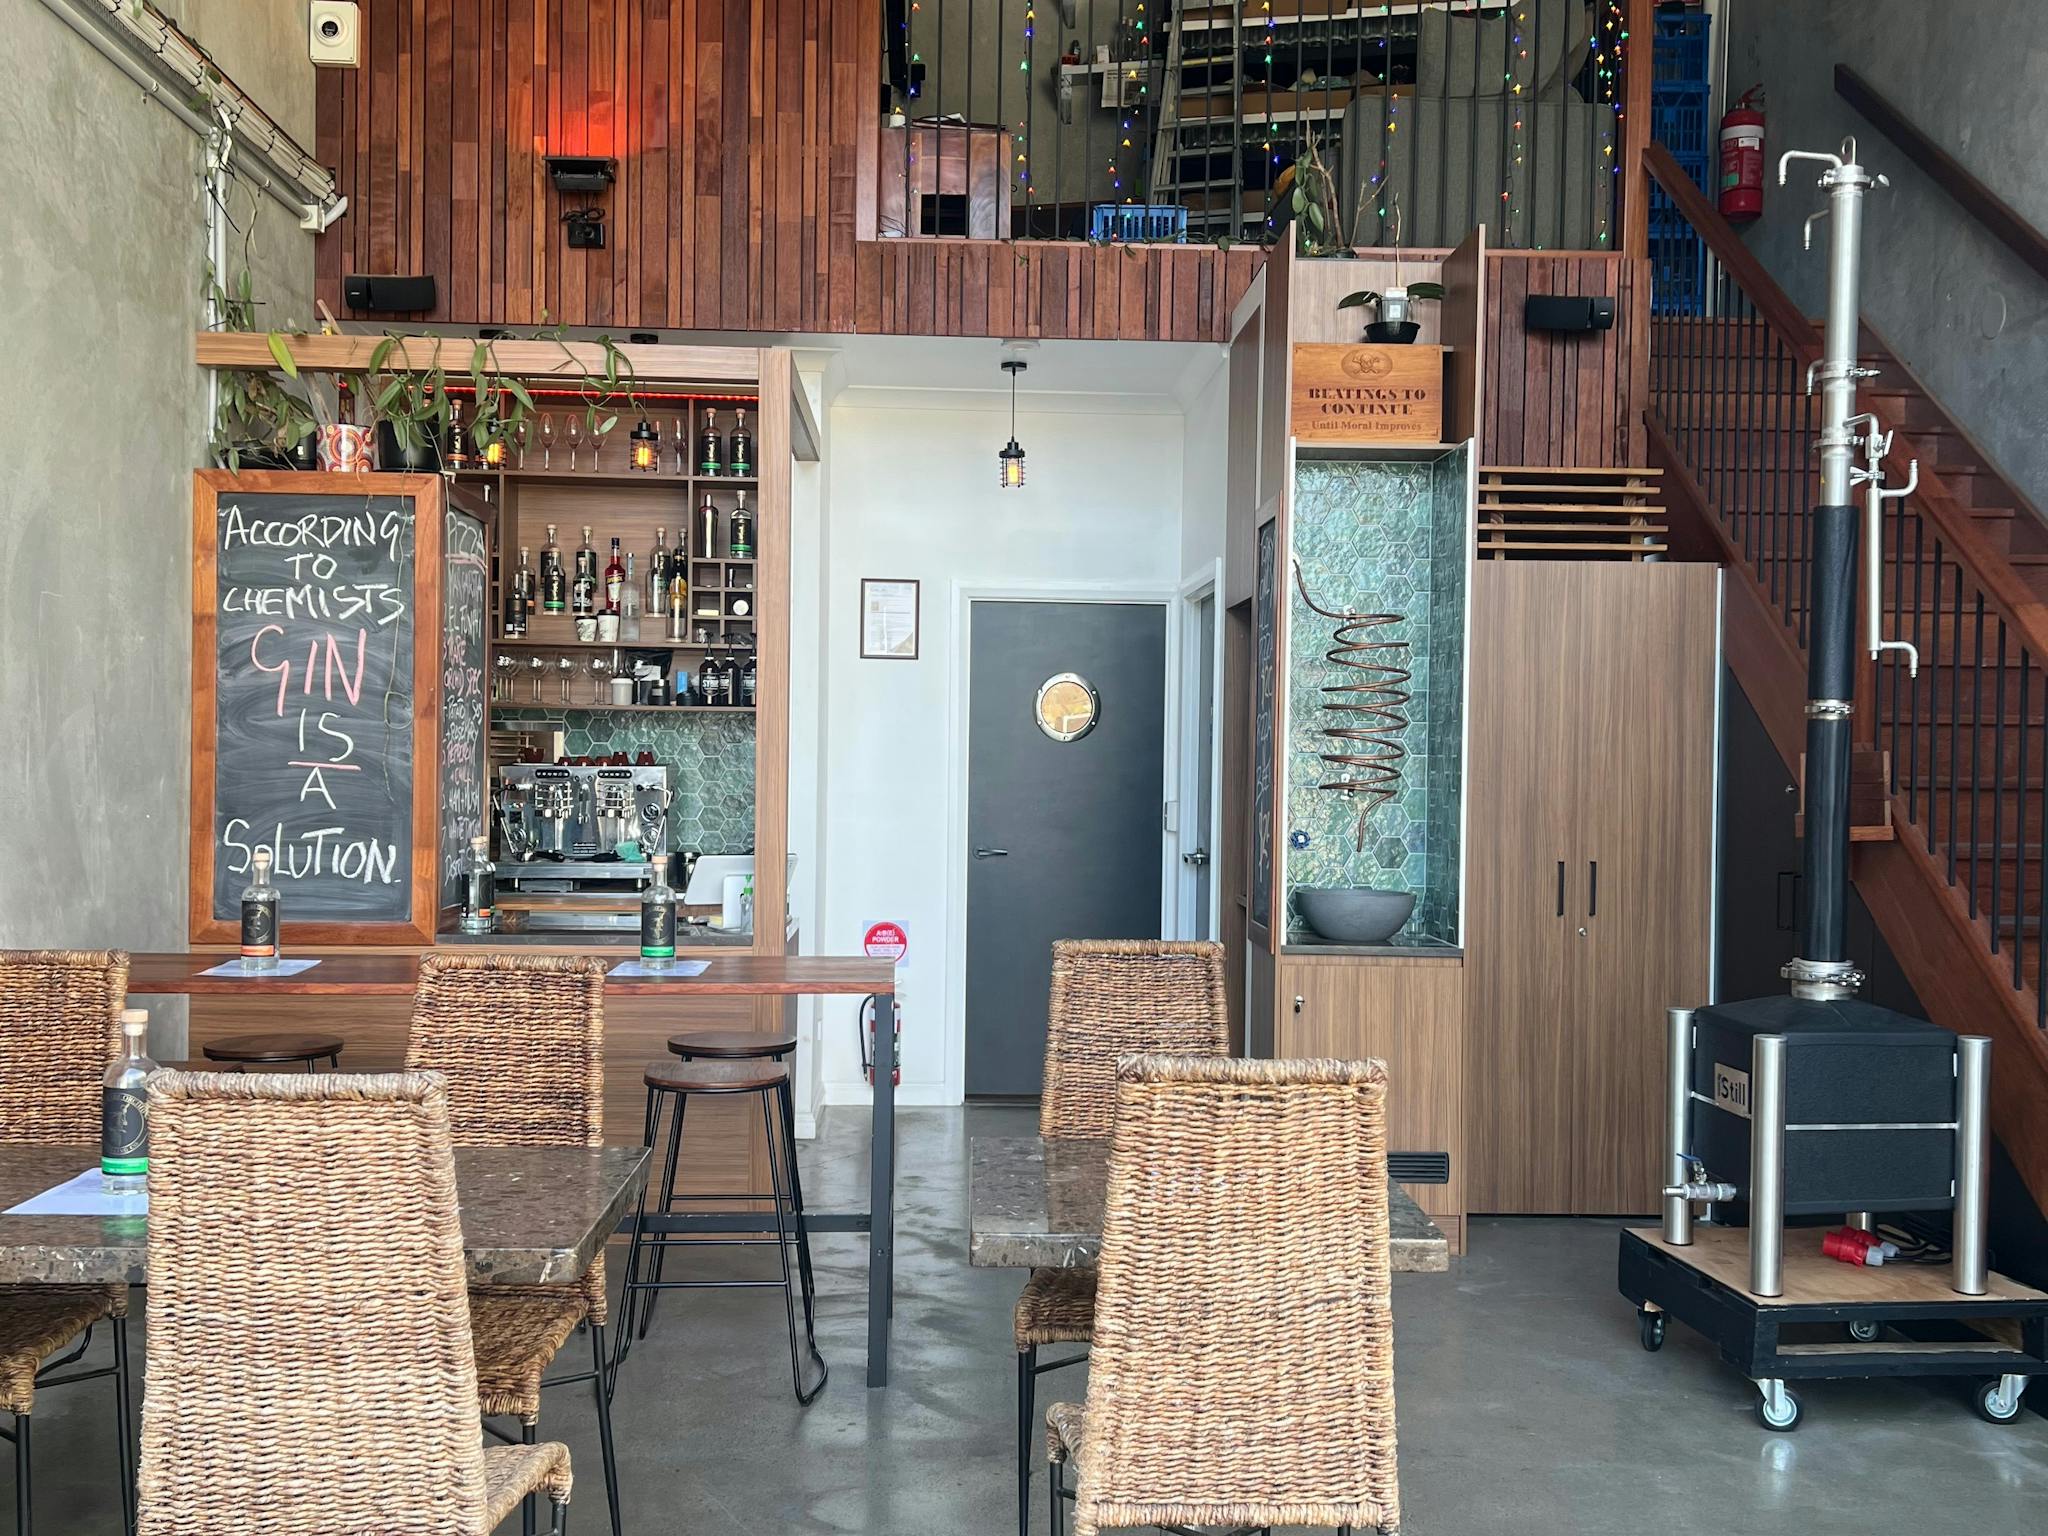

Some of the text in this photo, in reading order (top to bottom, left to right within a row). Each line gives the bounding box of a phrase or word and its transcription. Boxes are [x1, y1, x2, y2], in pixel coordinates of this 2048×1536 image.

[1309, 388, 1426, 401] BEATINGS TO
[1321, 403, 1413, 416] CONTINUE
[1312, 420, 1421, 433] Until Moral Improves
[223, 505, 399, 560] ACCORDING
[284, 553, 338, 580] TO
[223, 584, 405, 625] CHEMISTS
[251, 624, 367, 717] GIN
[298, 708, 354, 763] IS
[300, 766, 336, 810] A
